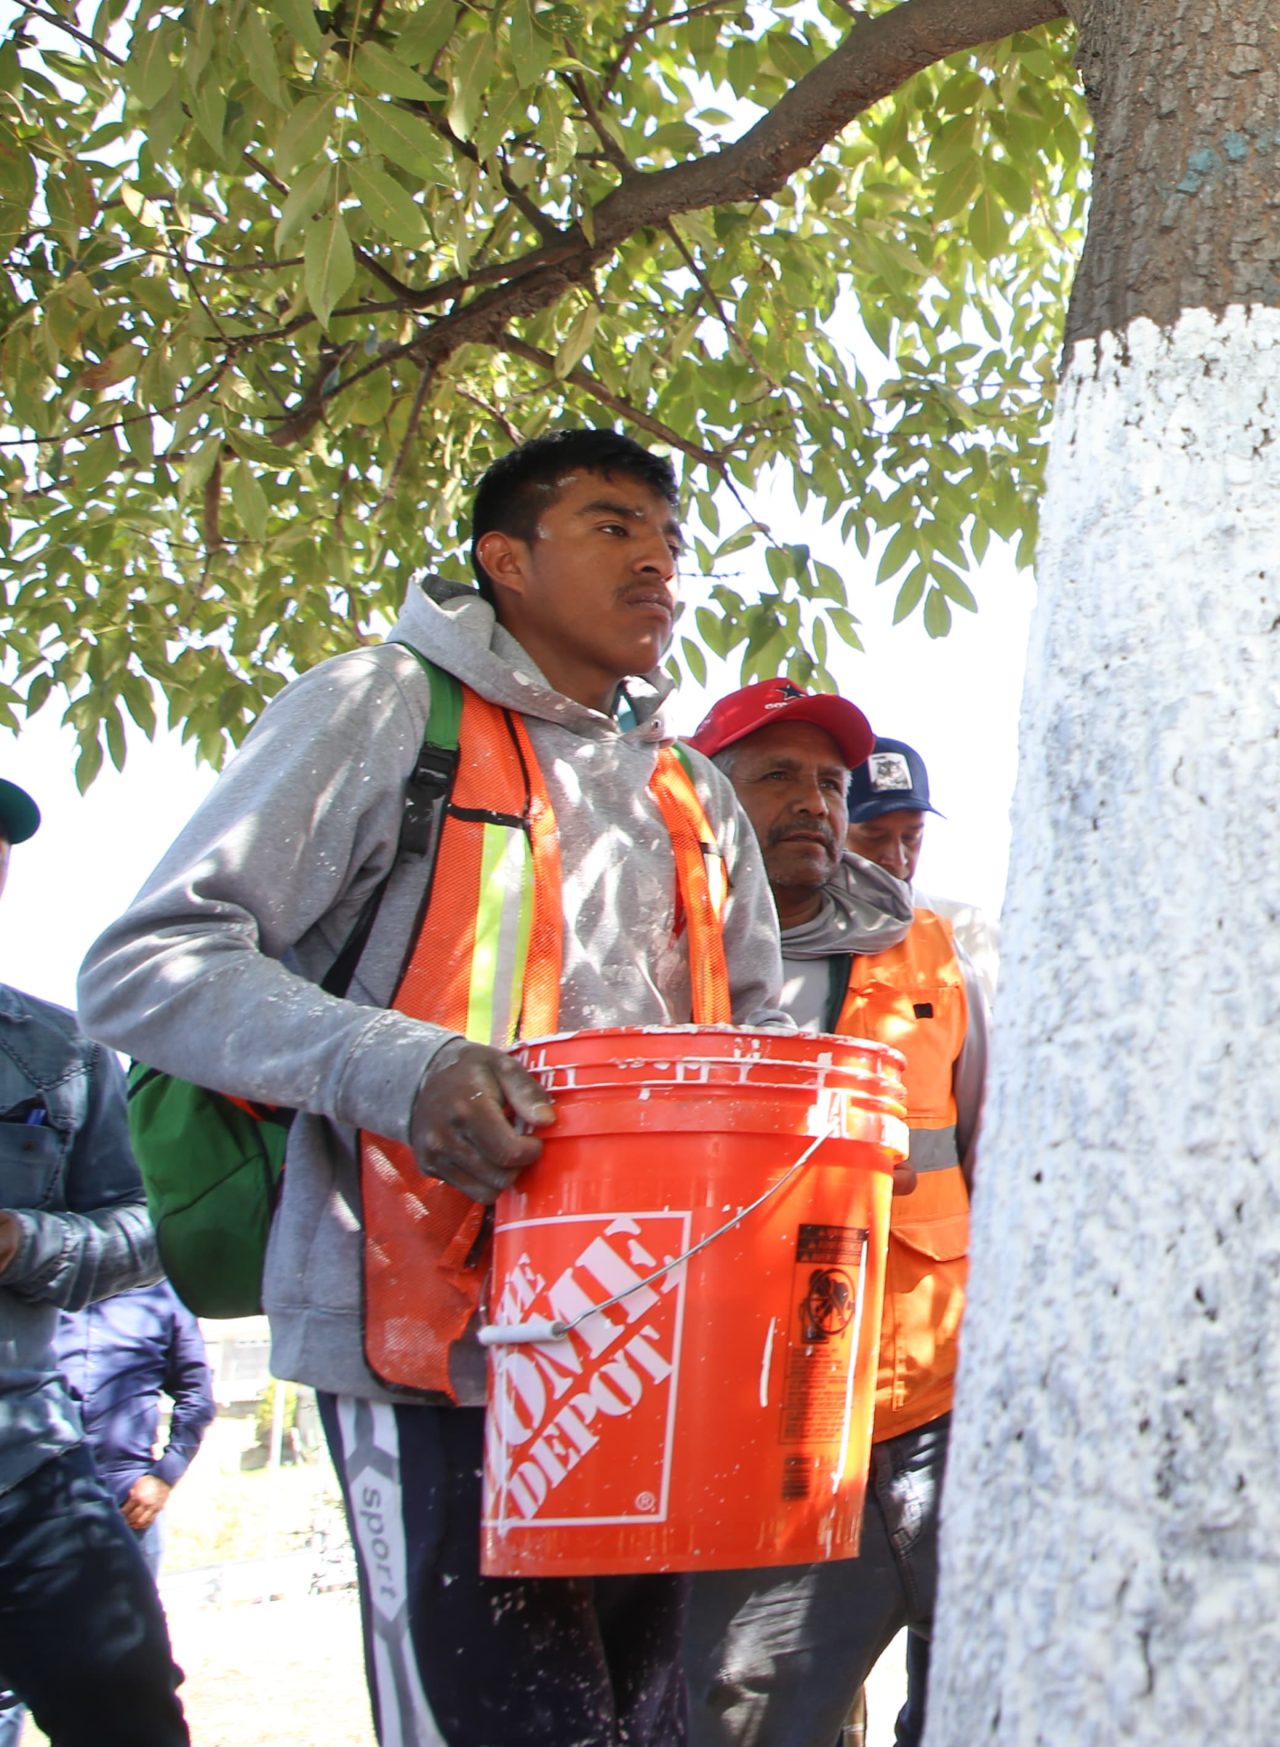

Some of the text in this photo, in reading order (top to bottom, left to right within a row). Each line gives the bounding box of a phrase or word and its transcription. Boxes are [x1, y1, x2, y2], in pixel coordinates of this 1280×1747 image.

[494, 1252, 546, 1327] HE
[508, 1325, 674, 1520] DEPOT
[360, 1486, 397, 1600] sport
